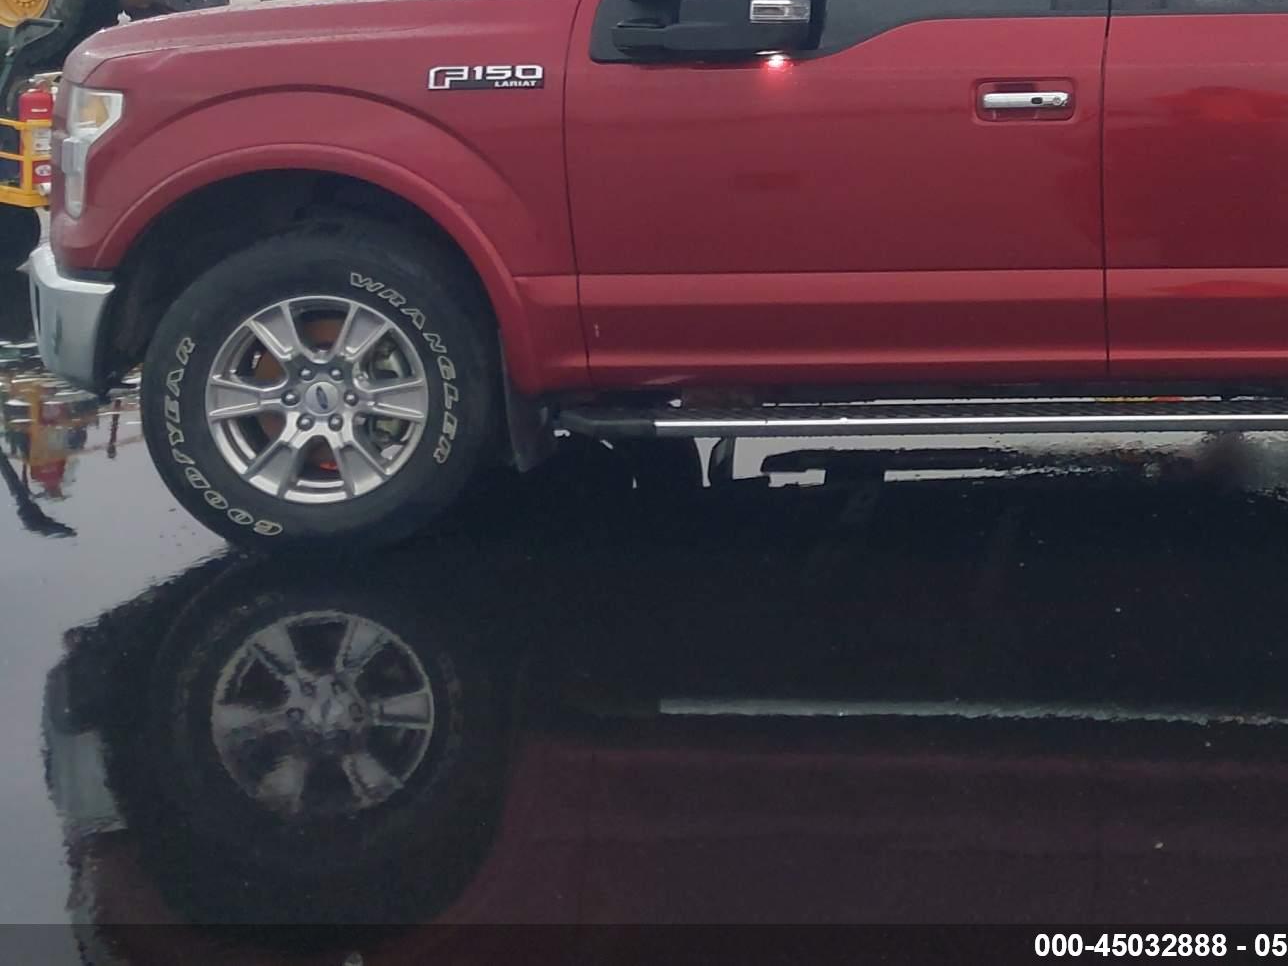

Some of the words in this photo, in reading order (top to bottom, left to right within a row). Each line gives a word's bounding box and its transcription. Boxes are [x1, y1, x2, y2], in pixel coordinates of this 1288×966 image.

[494, 80, 537, 88] LARIAT
[164, 336, 284, 536] GOODYEAR
[350, 271, 459, 464] WRANGLER
